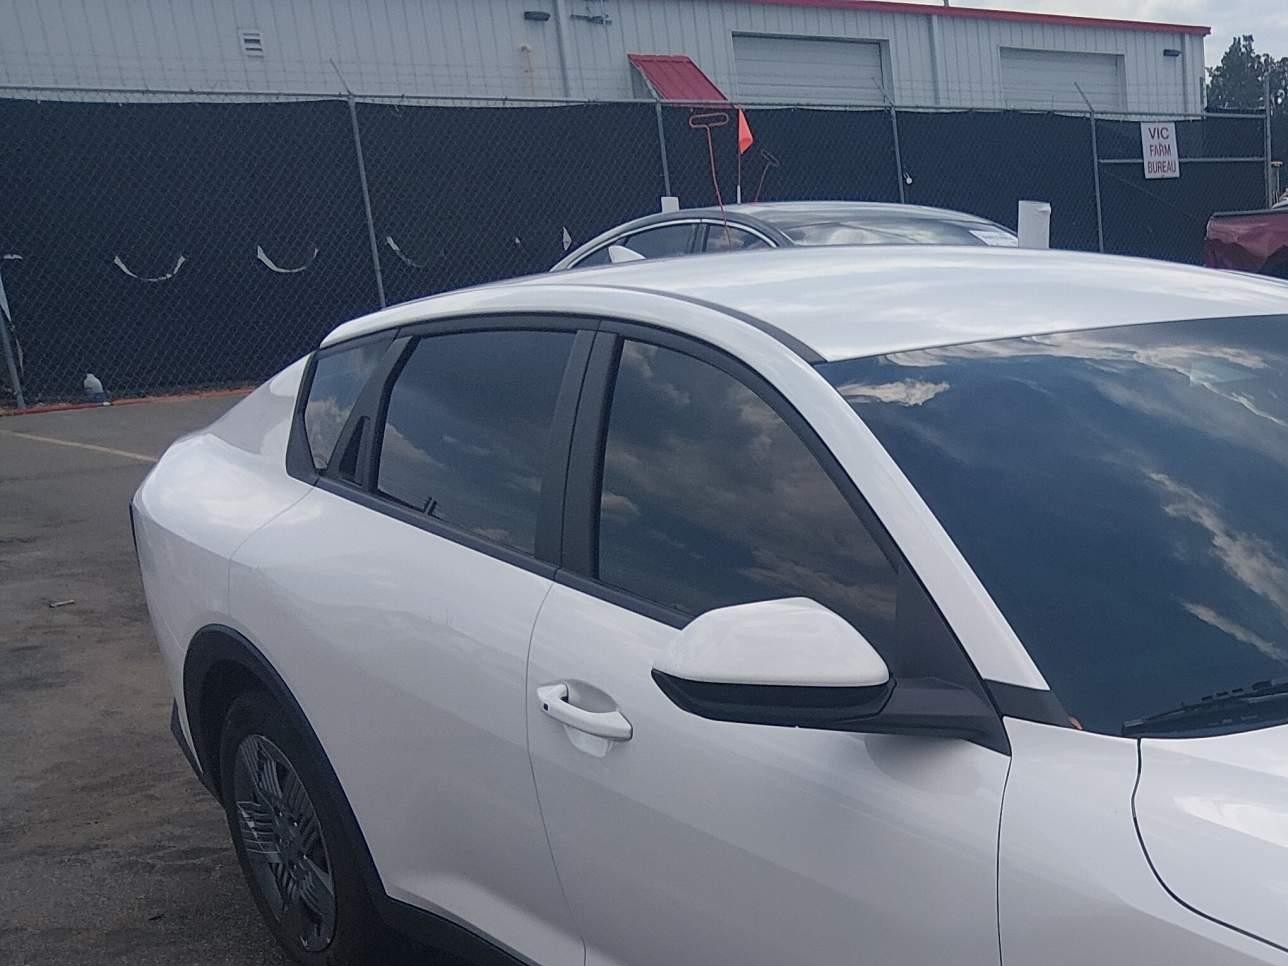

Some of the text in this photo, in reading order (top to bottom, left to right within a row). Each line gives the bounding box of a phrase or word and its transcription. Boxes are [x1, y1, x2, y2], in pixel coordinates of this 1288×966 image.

[1148, 127, 1169, 140] VIC
[1150, 143, 1172, 157] FARM
[1148, 160, 1177, 173] BUREAU
